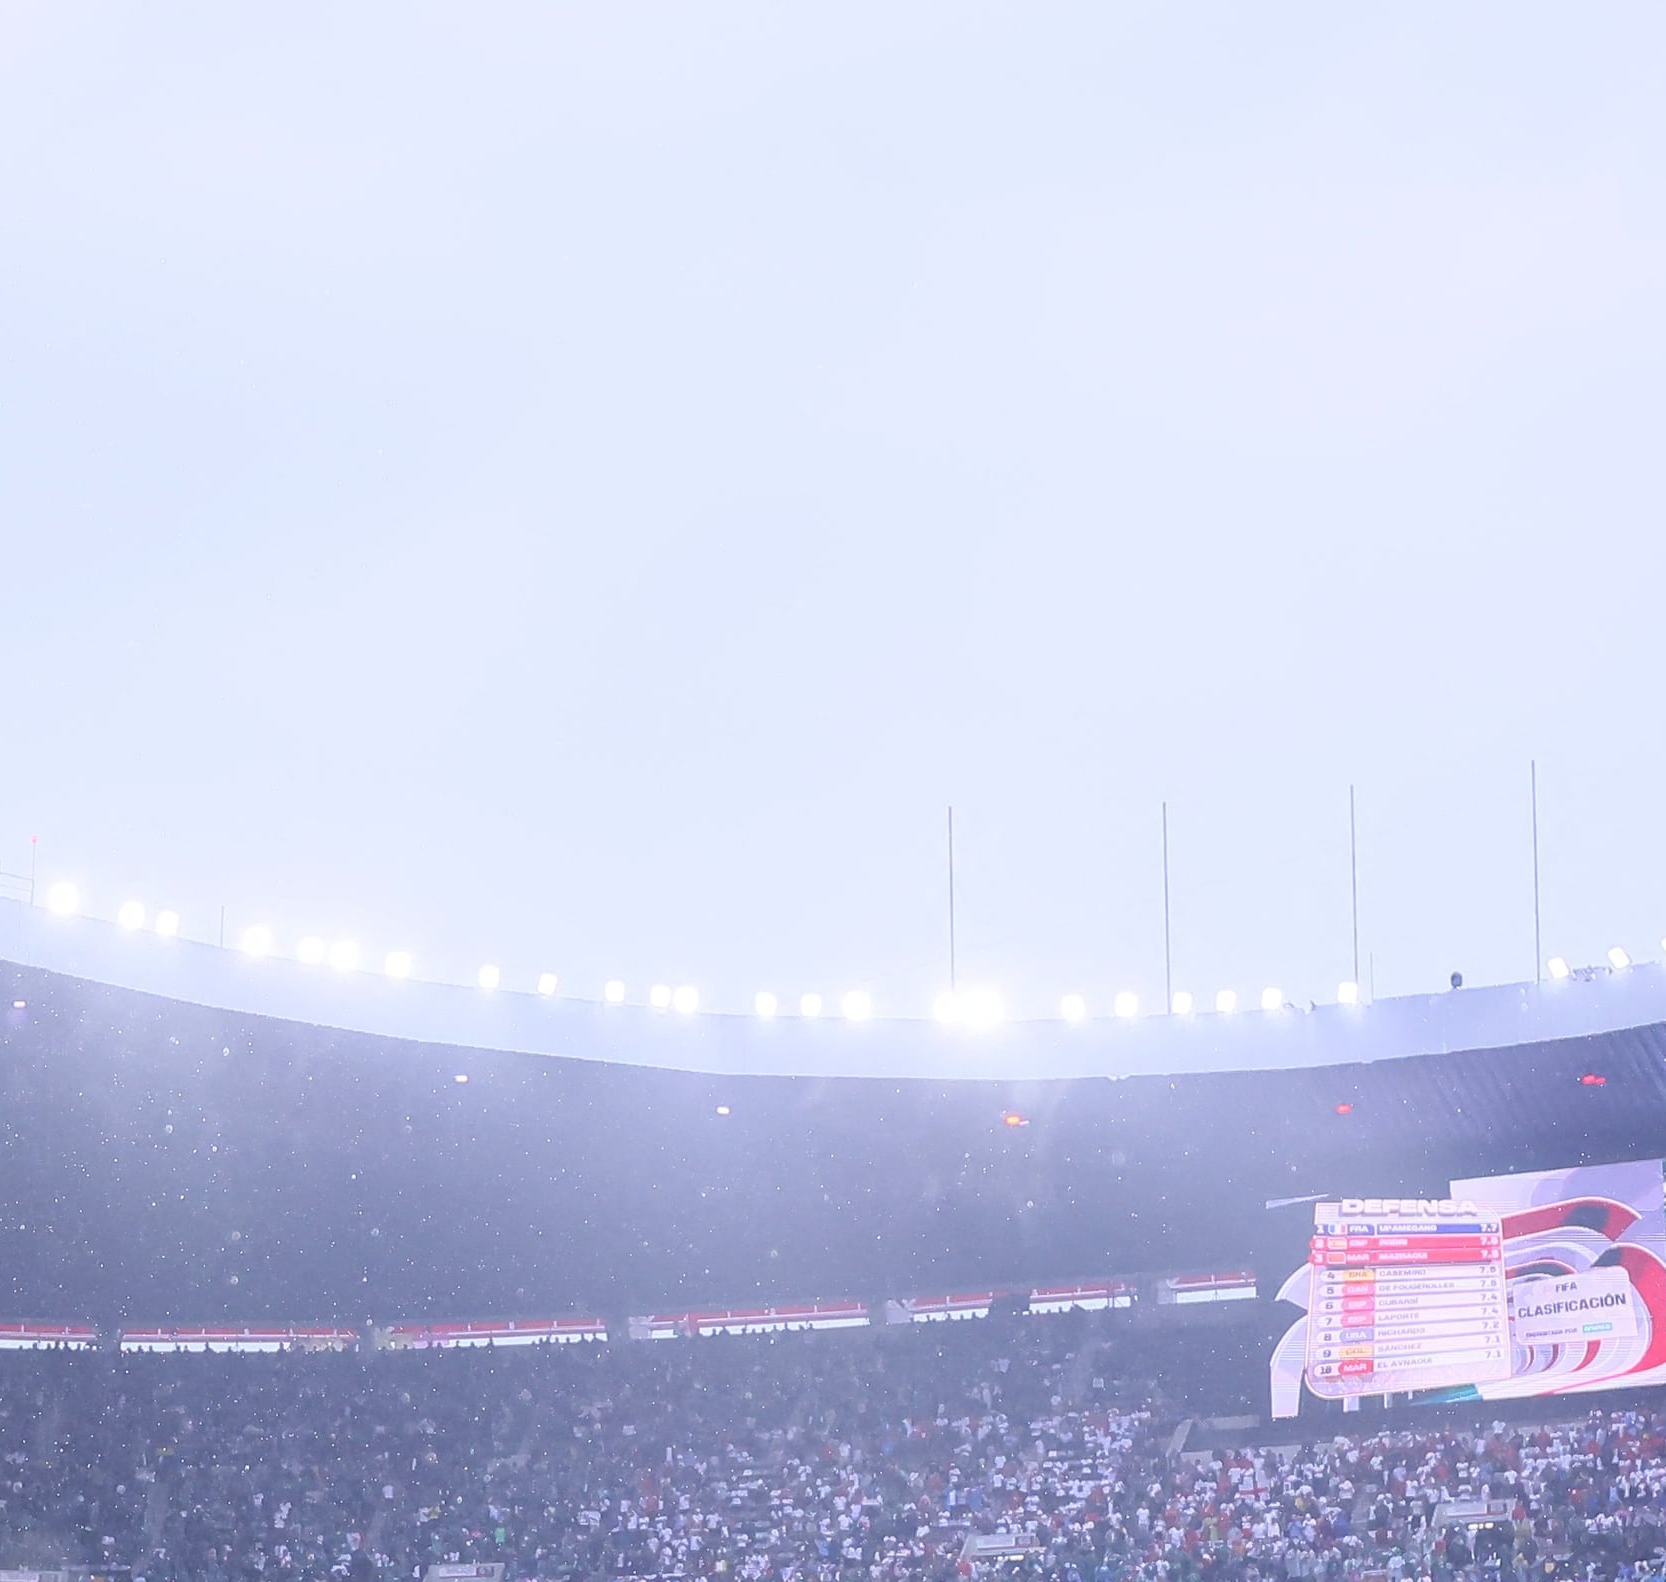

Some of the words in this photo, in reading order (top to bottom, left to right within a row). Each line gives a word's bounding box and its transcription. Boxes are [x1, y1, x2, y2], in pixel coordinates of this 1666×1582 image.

[1339, 1199, 1478, 1217] DEFENSA
[1555, 1281, 1578, 1293] FIFA
[1518, 1293, 1627, 1319] CLASIFICACIÓN
[1343, 1363, 1368, 1372] MAR
